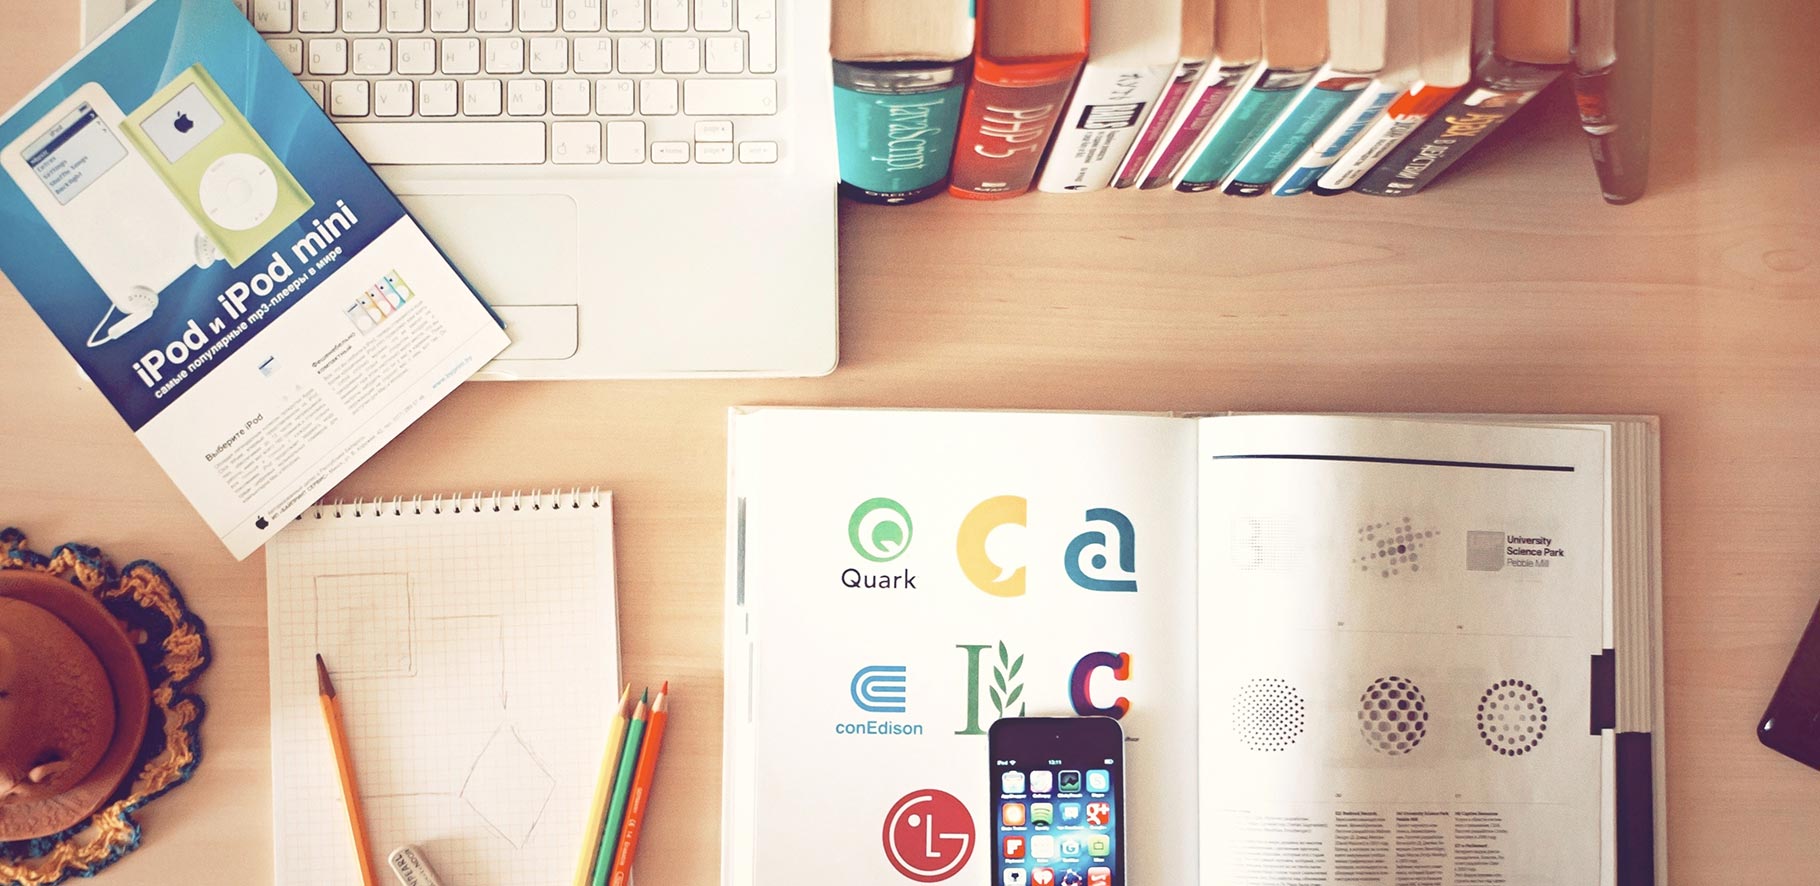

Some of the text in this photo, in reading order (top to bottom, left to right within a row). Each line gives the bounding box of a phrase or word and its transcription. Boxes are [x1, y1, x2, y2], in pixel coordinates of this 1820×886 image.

[872, 97, 945, 172] JavaScript
[979, 103, 1054, 144] PHP
[1440, 113, 1504, 137] Ajax
[974, 143, 1038, 159] 5
[132, 199, 359, 388] iPod и iPod mini
[154, 246, 343, 399] самые популярные mp3-плееры в мире
[204, 412, 264, 462] Выберите iPod
[1506, 546, 1565, 557] Science Park
[1507, 536, 1552, 547] University
[1507, 558, 1549, 568] Pebble Mill
[841, 567, 917, 591] Quark
[835, 721, 923, 736] conEdison
